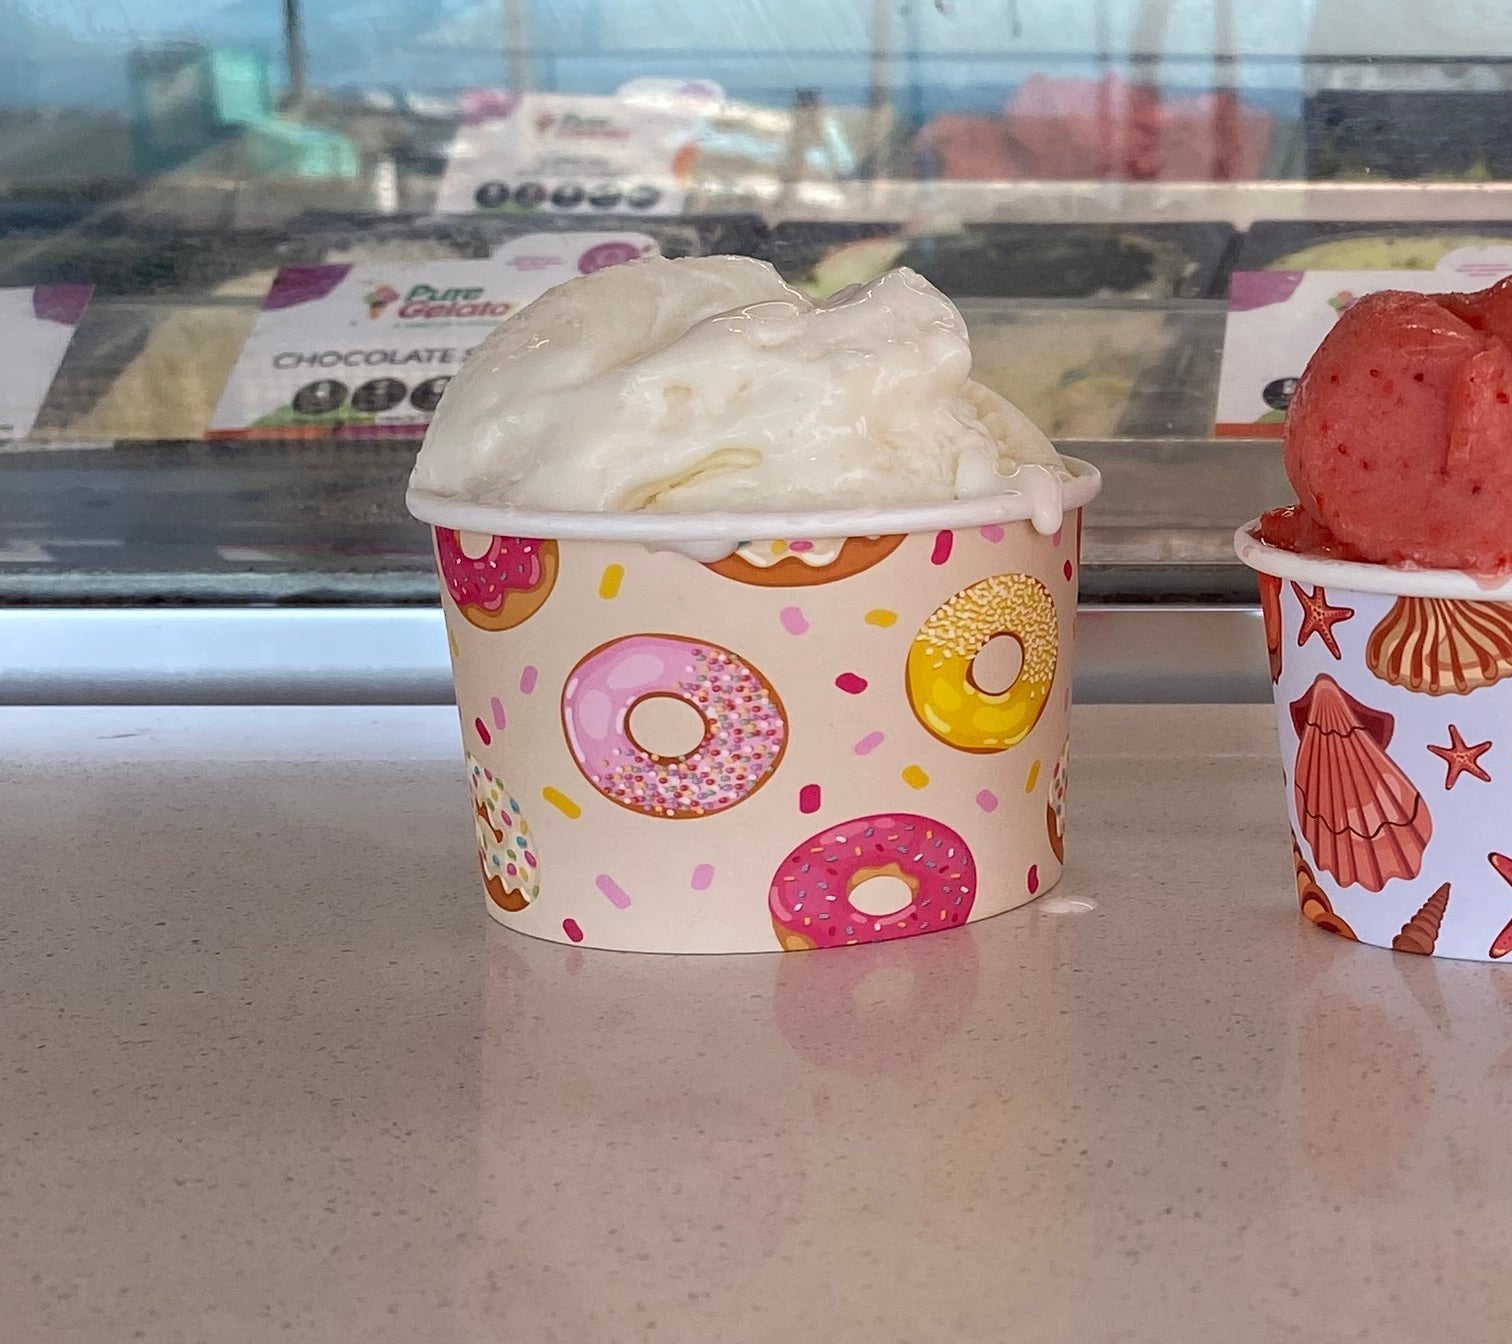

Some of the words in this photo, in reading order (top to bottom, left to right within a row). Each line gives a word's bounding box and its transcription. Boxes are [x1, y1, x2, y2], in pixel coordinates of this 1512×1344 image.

[404, 283, 485, 302] Pure
[397, 301, 512, 320] Gelato
[273, 347, 457, 370] CHOCOLATE
